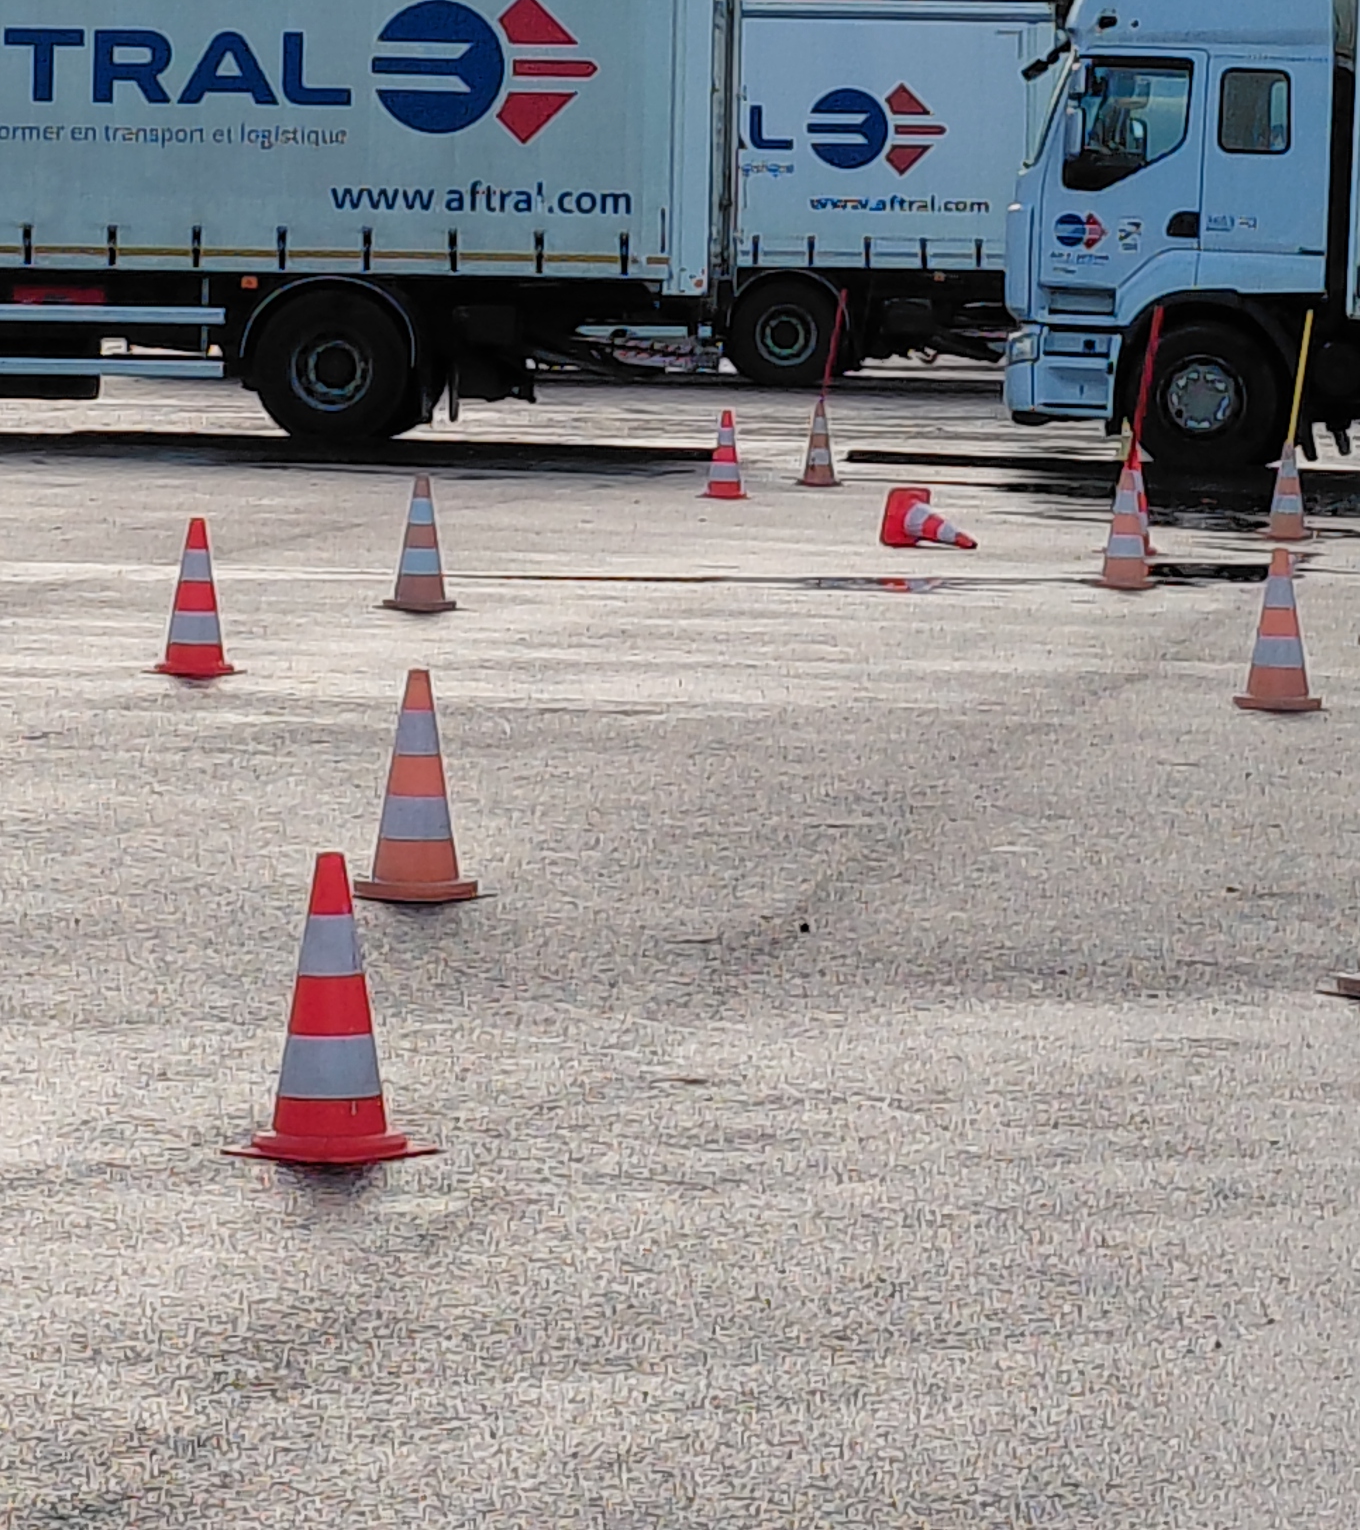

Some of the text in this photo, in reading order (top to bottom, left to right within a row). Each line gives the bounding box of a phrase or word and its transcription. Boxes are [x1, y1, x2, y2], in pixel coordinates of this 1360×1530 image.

[70, 125, 97, 142] en
[104, 123, 205, 148] transport
[212, 125, 233, 144] et
[330, 179, 633, 215] wwwaftral.com
